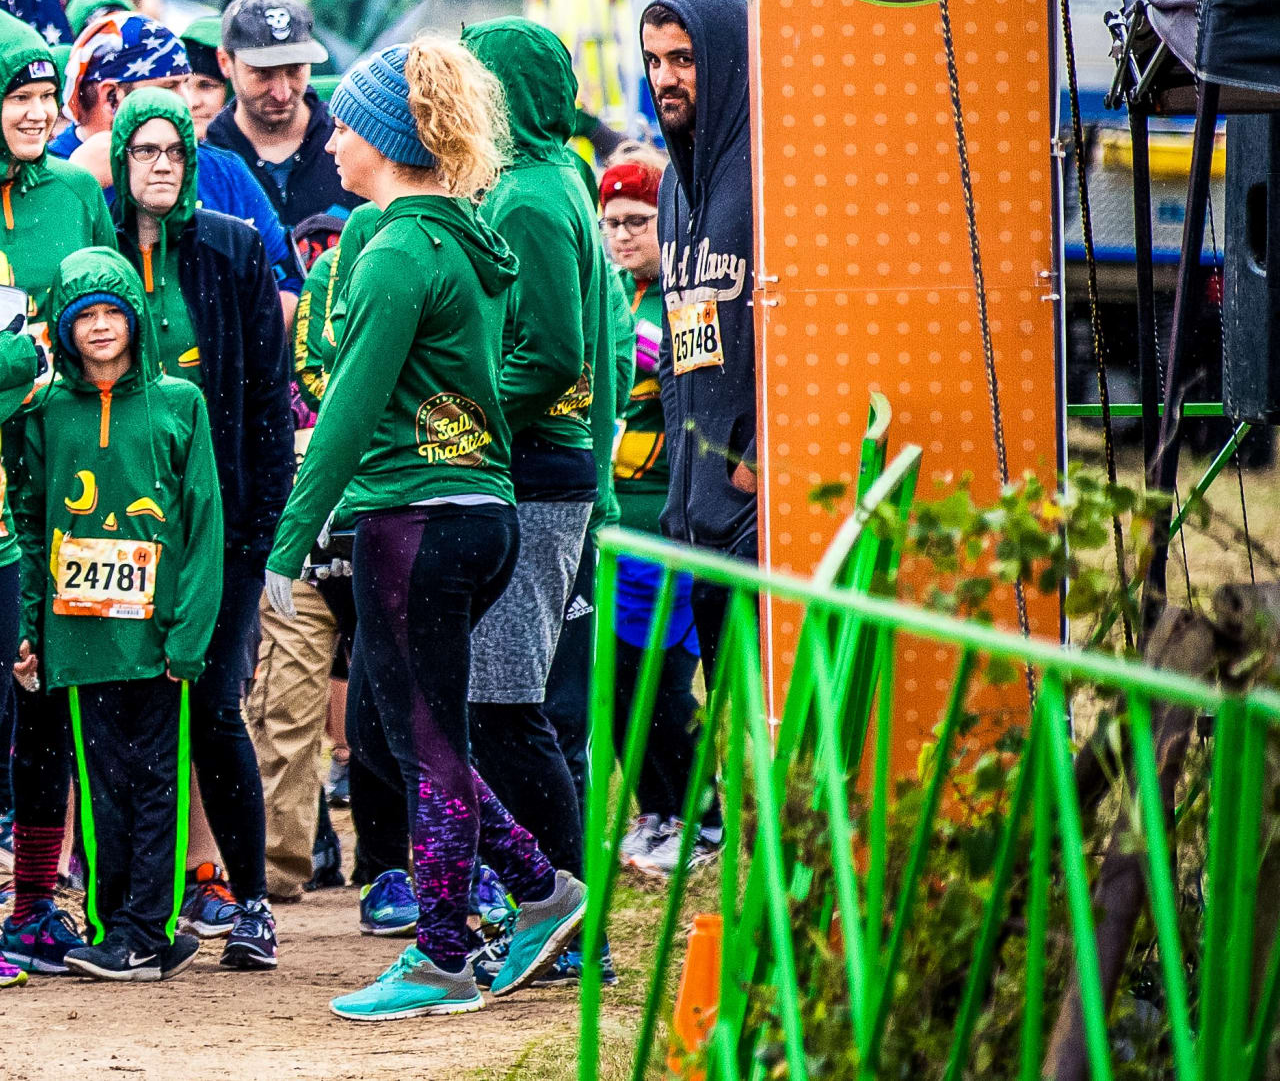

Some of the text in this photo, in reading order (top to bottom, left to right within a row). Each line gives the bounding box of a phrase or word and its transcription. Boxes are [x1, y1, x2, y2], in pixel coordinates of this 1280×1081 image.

[695, 237, 746, 301] Navy
[674, 324, 718, 362] 25748
[138, 552, 147, 561] H
[65, 561, 147, 592] 24781
